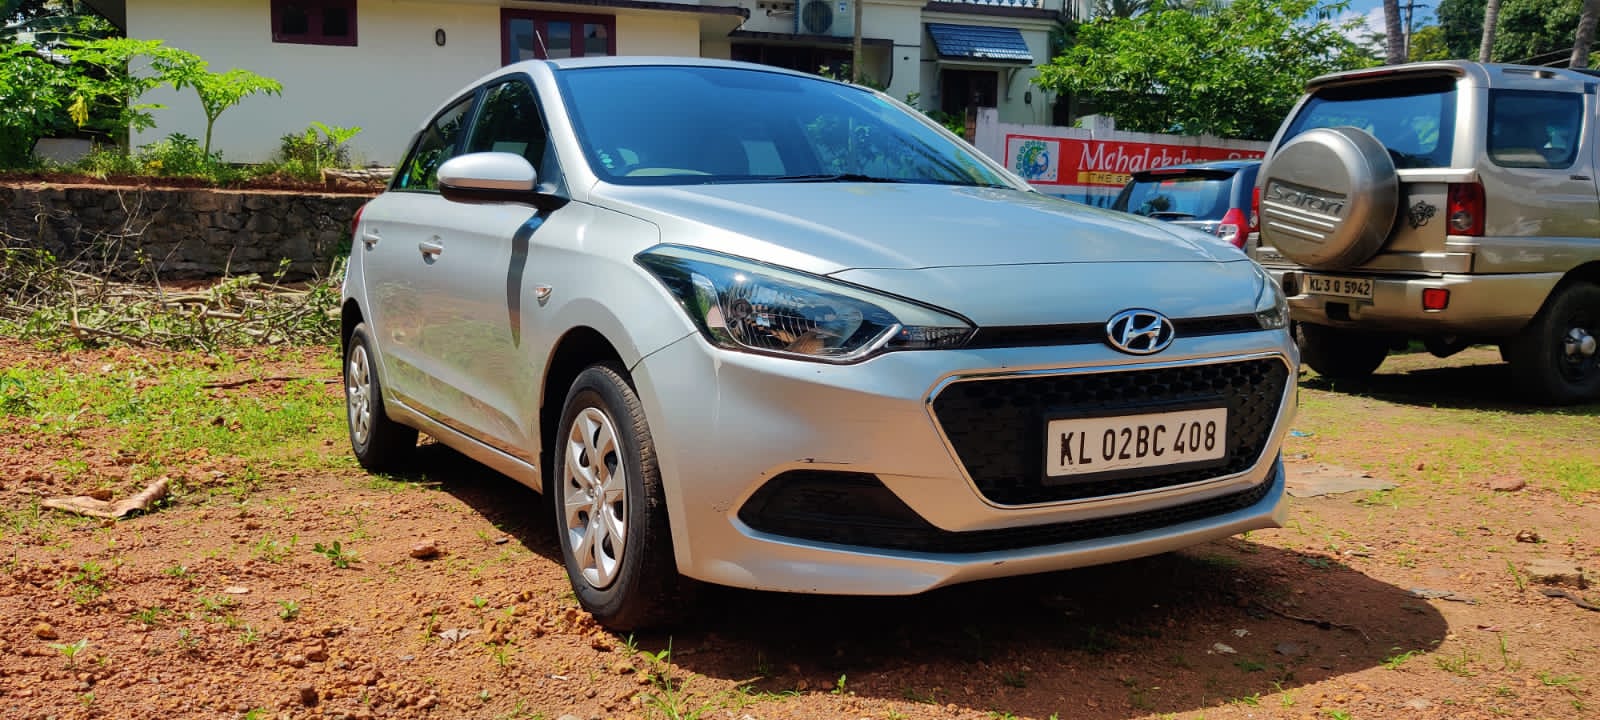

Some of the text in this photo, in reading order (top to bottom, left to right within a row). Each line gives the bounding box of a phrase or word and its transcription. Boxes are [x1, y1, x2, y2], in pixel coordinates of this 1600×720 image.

[1272, 183, 1345, 216] Safari
[1344, 280, 1370, 295] 5942
[1060, 431, 1092, 466] KL
[1173, 420, 1217, 454] 408
